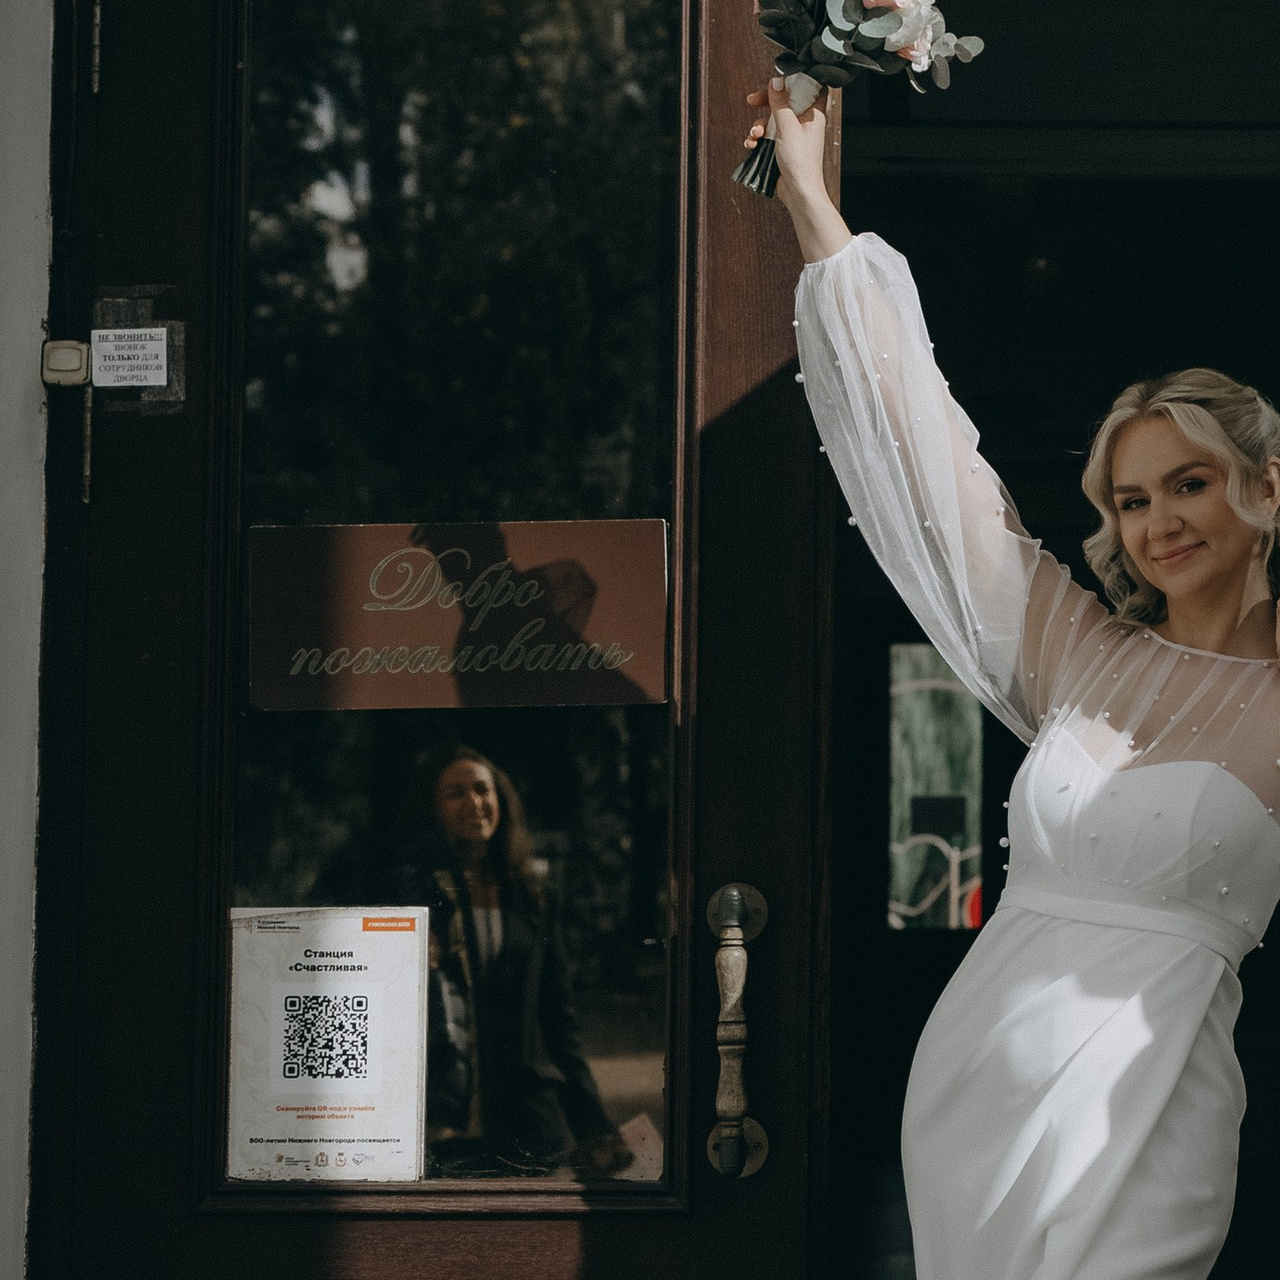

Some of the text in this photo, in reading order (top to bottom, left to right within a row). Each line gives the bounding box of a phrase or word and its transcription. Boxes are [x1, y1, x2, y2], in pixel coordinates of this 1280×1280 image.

[98, 334, 111, 342] НЕ
[113, 343, 148, 351] ЗВОНОК
[99, 364, 162, 372] СОТРУДНИКОВ
[362, 547, 546, 630] Добро
[289, 619, 633, 676] пожаловать
[303, 948, 354, 958] Станция
[288, 962, 368, 972] «Счастливая»
